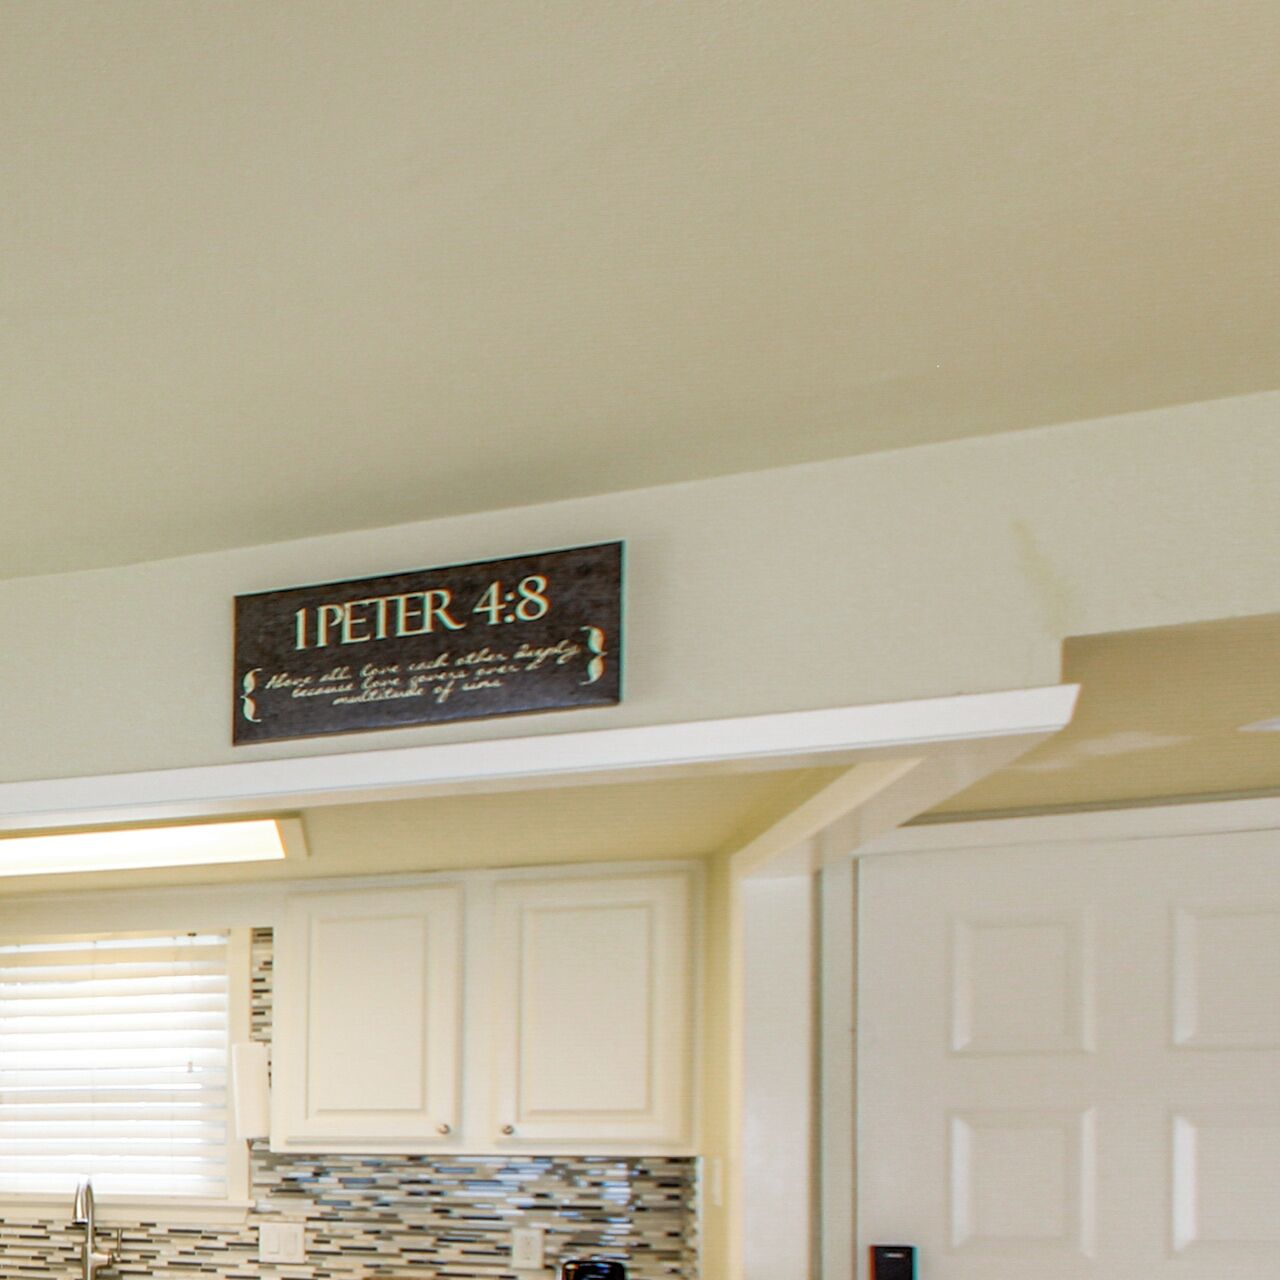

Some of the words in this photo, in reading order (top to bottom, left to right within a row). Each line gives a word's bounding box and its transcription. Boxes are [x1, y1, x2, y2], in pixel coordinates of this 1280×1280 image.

[316, 588, 466, 649] PETER
[472, 574, 550, 627] 4:8
[360, 663, 400, 678] love
[408, 652, 450, 671] each
[454, 646, 509, 667] other
[360, 676, 400, 690] love
[432, 680, 455, 704] of
